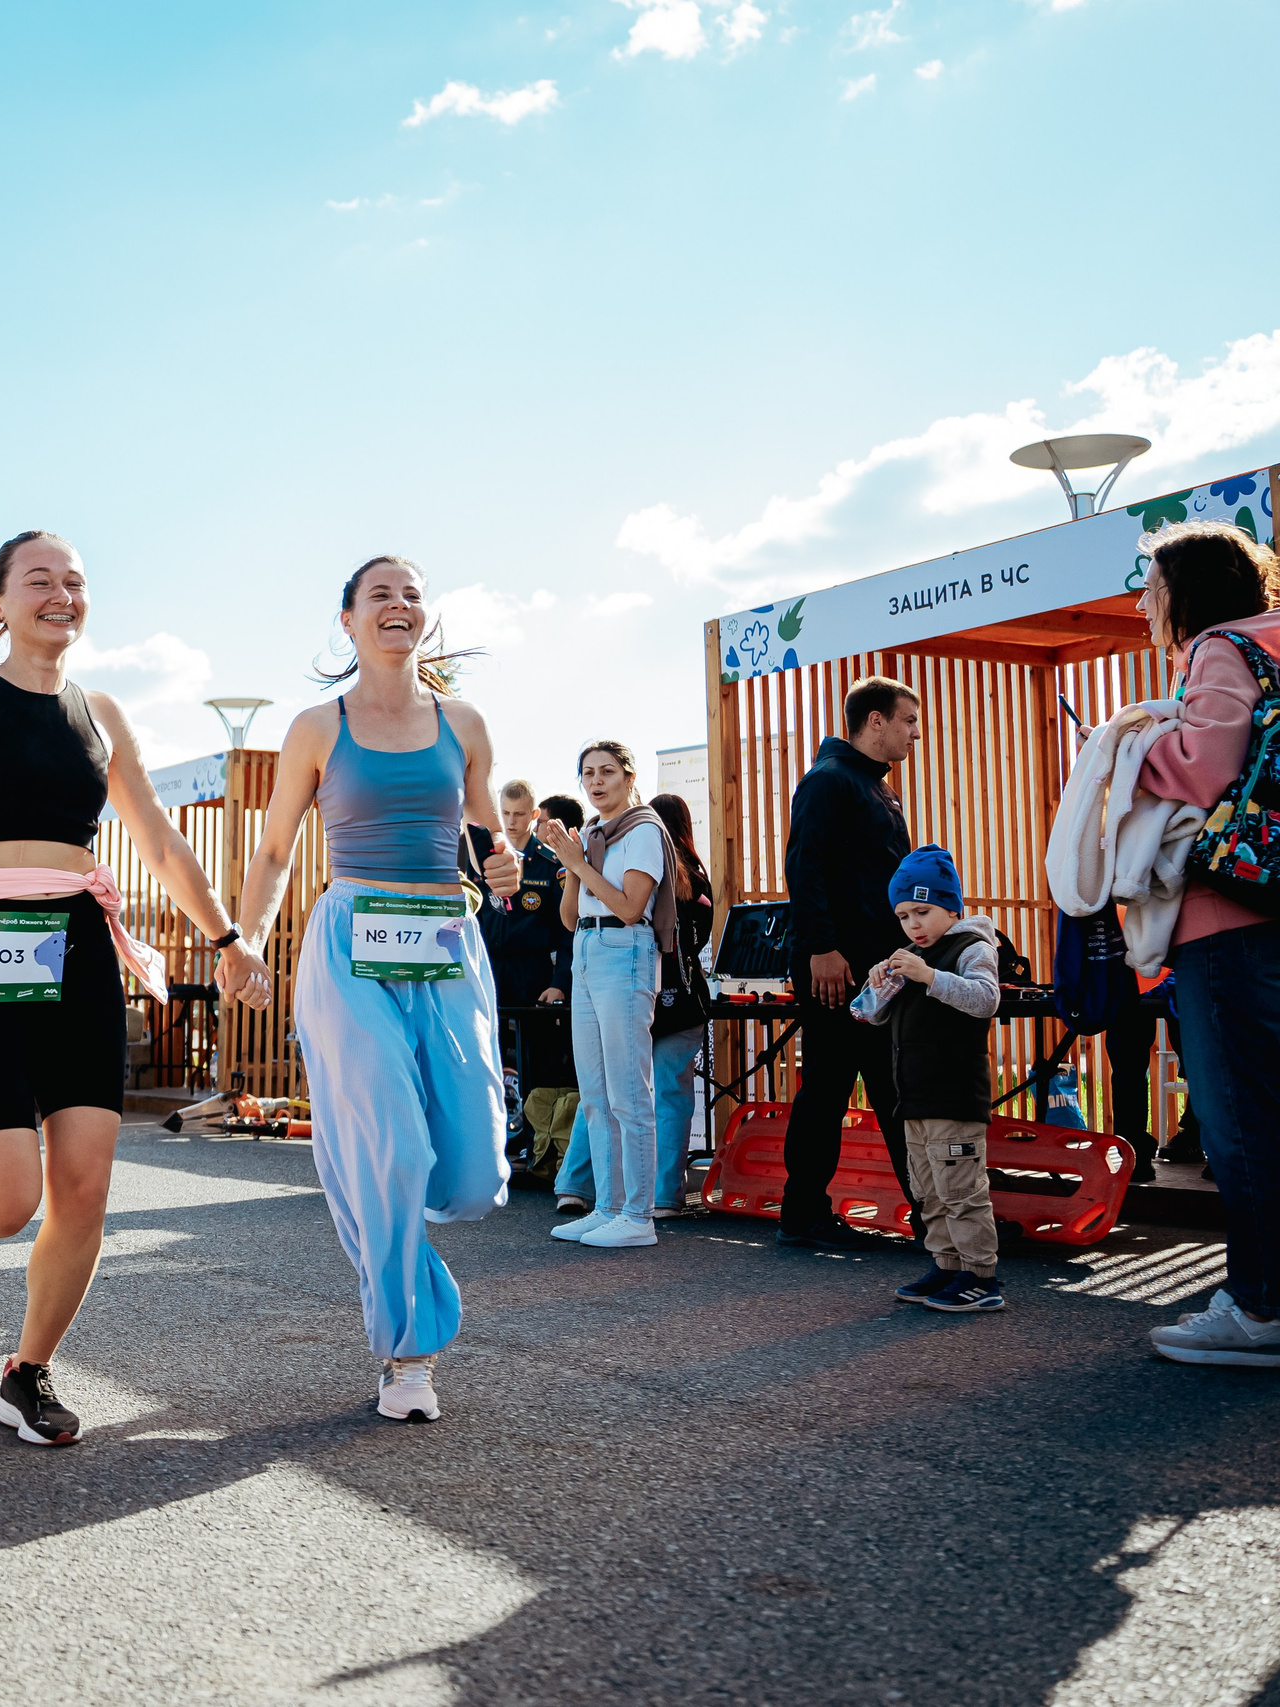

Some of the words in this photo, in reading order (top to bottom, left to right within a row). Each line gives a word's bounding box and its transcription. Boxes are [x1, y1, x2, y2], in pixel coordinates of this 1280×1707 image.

[888, 579, 972, 616] ЗАЩИТА
[980, 573, 993, 594] В
[1000, 563, 1030, 587] ЧС
[155, 779, 182, 793] ТЁРСТВО
[366, 929, 387, 943] №
[395, 930, 423, 944] 177
